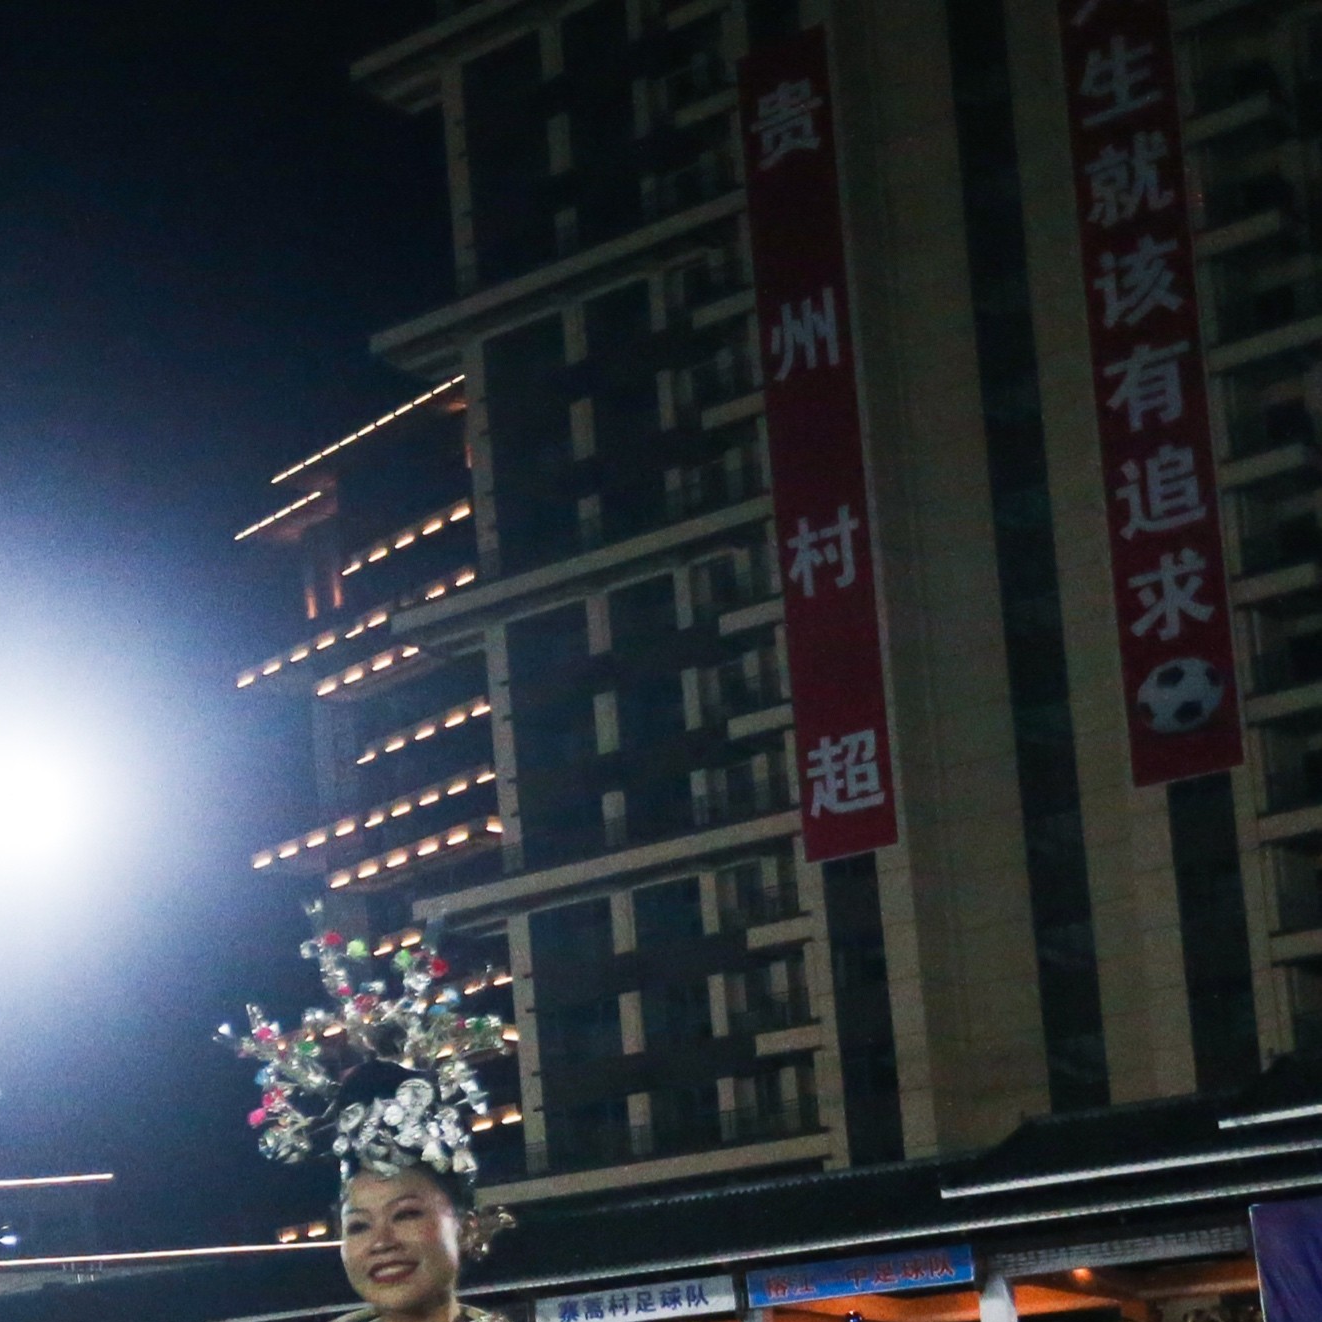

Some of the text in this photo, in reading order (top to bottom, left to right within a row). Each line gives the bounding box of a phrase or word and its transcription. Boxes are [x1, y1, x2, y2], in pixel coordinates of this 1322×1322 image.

[750, 76, 886, 819] 贵州村超
[1070, 0, 1214, 642] 生就该有追求
